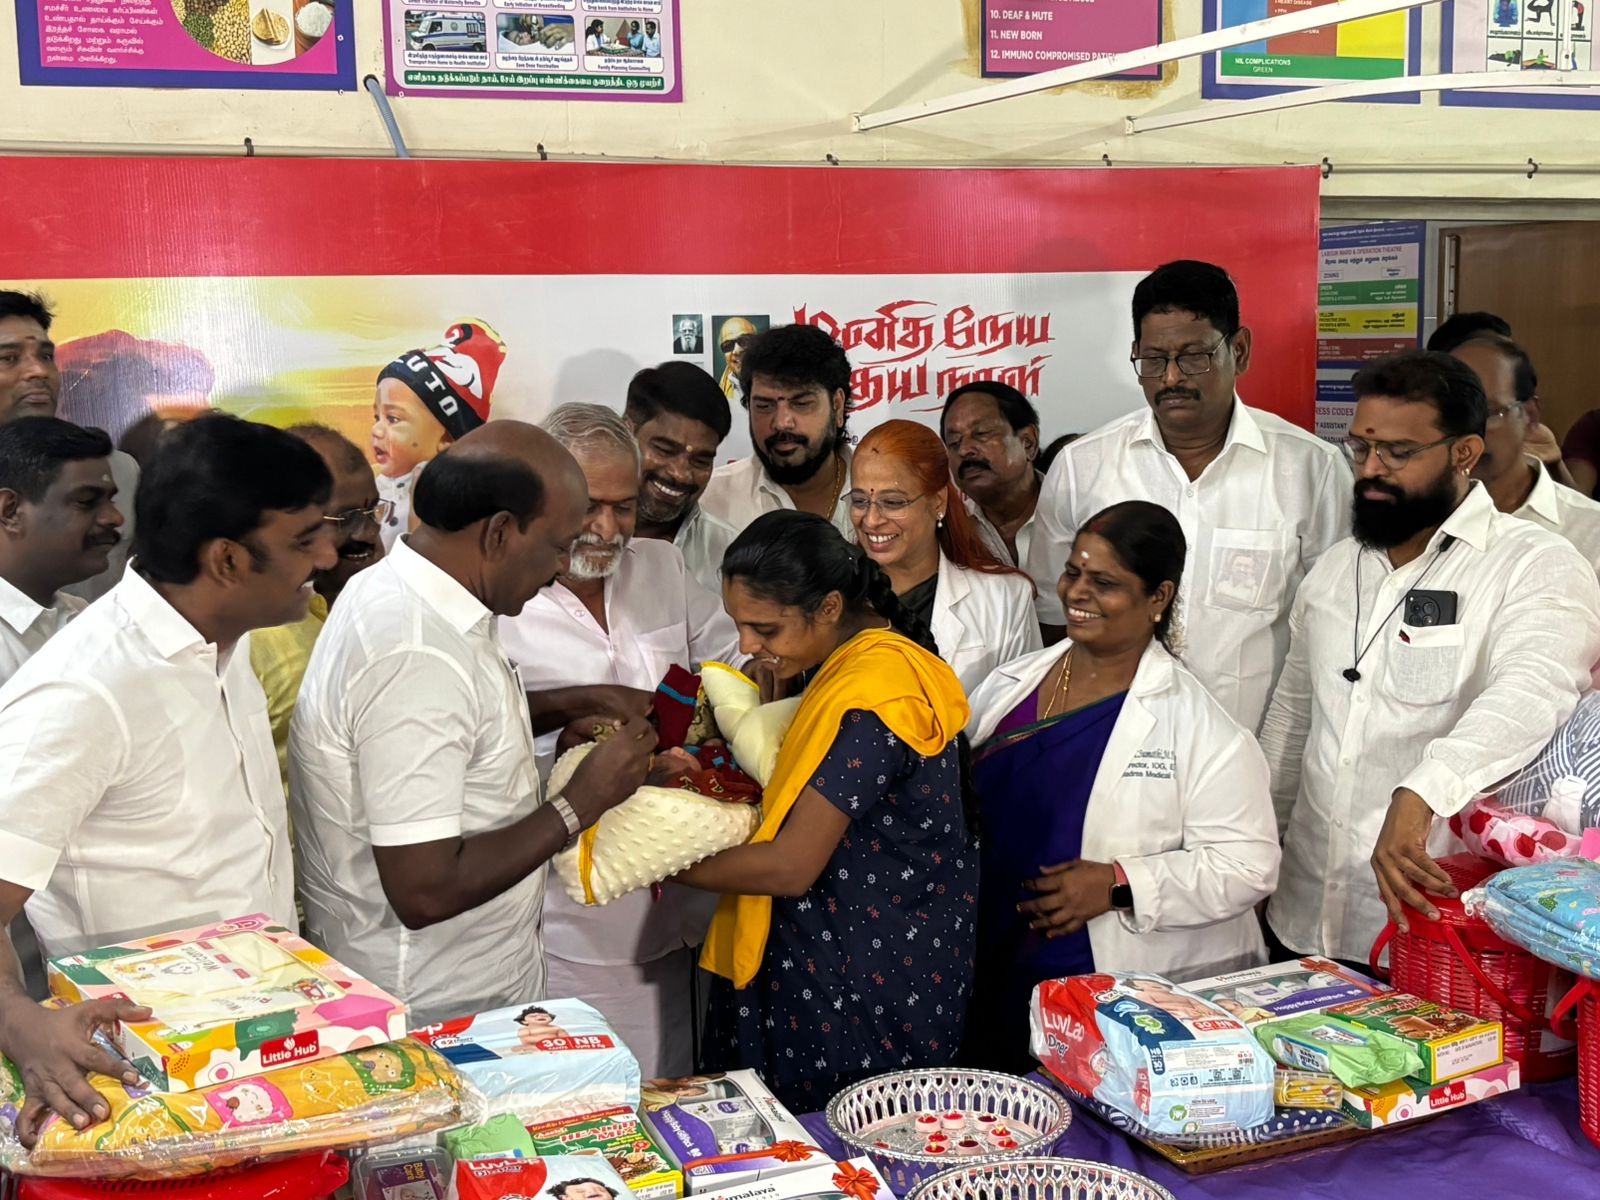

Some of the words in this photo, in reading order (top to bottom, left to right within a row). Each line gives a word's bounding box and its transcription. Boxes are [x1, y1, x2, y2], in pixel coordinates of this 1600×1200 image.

[990, 10, 1001, 19] 10.
[1003, 10, 1023, 19] DEAF
[1025, 11, 1030, 19] &
[1032, 11, 1053, 20] MUTE
[990, 30, 999, 39] 11.
[1000, 30, 1019, 39] NEW
[1021, 31, 1043, 40] BORN
[990, 50, 1001, 59] 12.
[1002, 51, 1033, 60] IMMUNO
[1035, 51, 1091, 61] COMPROMISED
[1245, 58, 1291, 66] COMPLICATIONS
[932, 304, 1056, 358] நேய
[395, 355, 459, 417] UTO
[848, 358, 930, 413] தய
[1332, 407, 1354, 417] CODES
[1320, 422, 1347, 430] ASSISTANT
[1146, 771, 1171, 779] Medical
[542, 1038, 567, 1047] 30
[574, 1036, 601, 1046] NB
[262, 1050, 292, 1064] Little
[294, 1043, 317, 1057] Hub
[1431, 1096, 1449, 1107] Little
[1450, 1092, 1465, 1102] Hub
[559, 1121, 637, 1144] HEALTH
[414, 1161, 425, 1180] Baby
[469, 1158, 541, 1171] LuvLap
